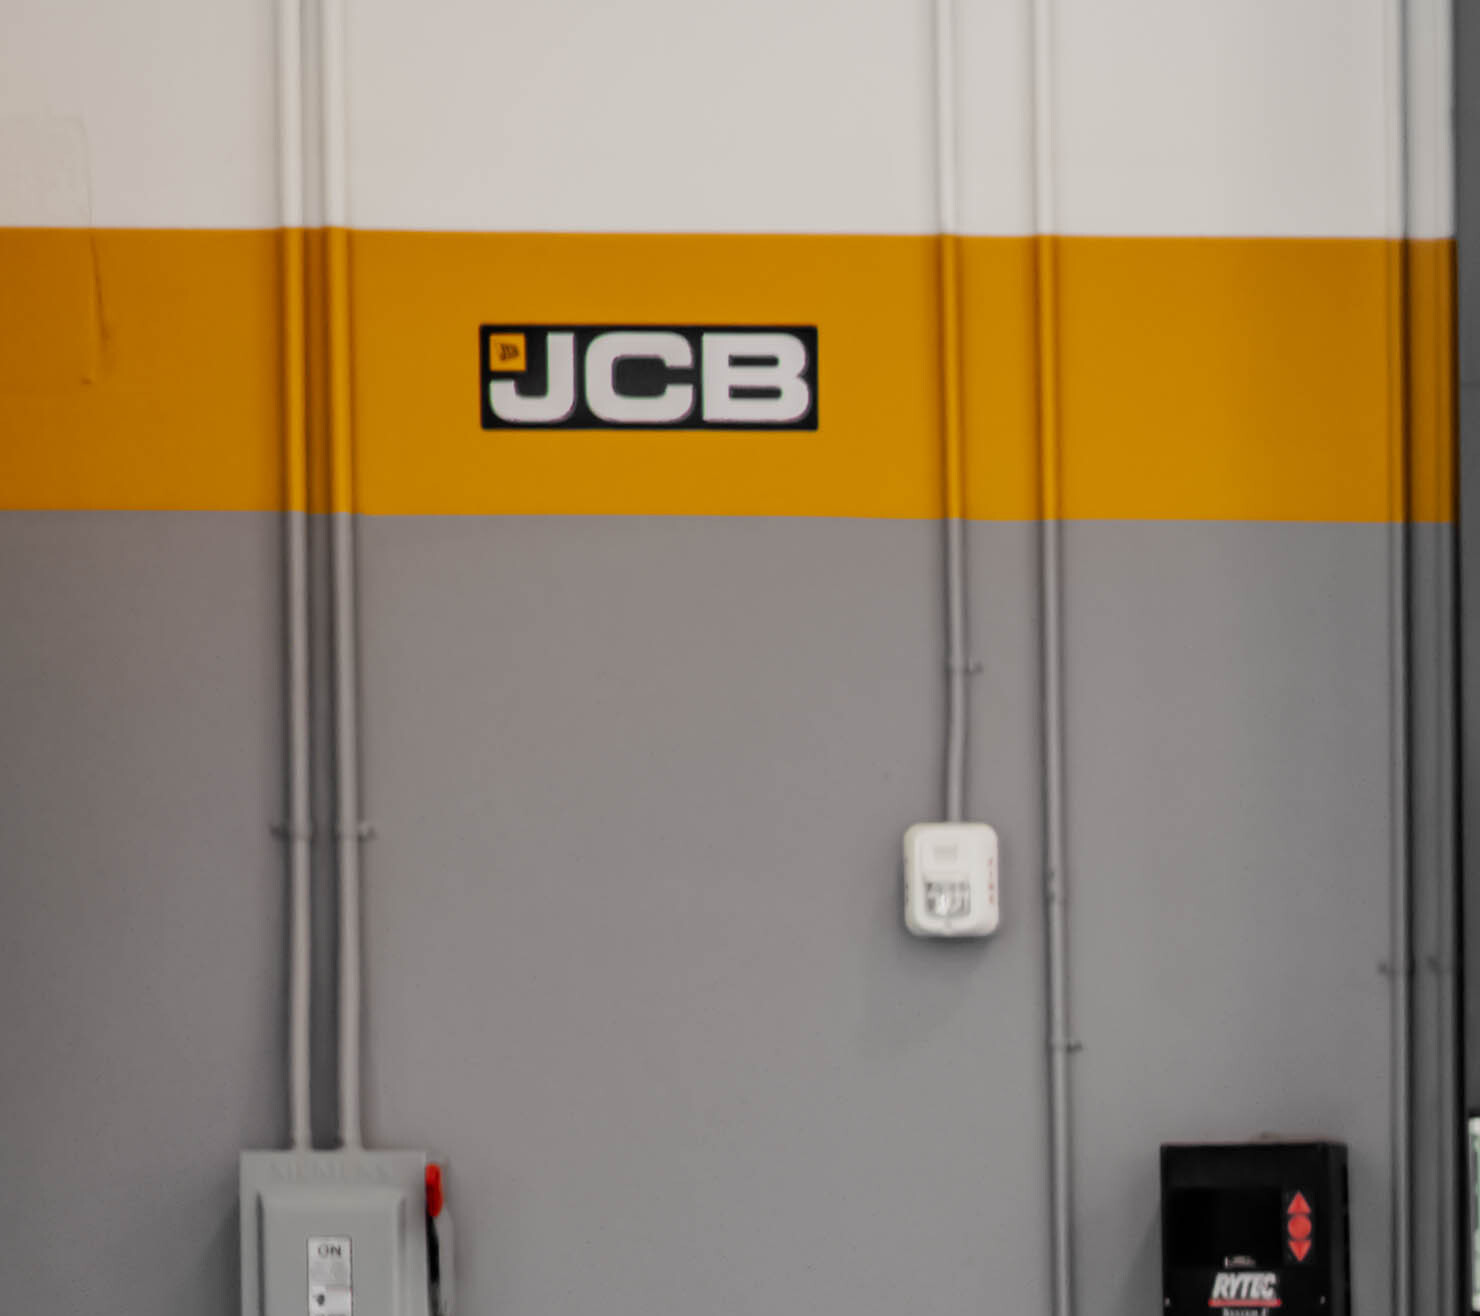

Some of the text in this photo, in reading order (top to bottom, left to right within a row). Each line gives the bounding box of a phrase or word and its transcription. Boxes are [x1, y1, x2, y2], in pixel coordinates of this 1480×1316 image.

[489, 331, 811, 423] JCB
[317, 1244, 342, 1258] ON
[1210, 1271, 1277, 1300] RYTEC
